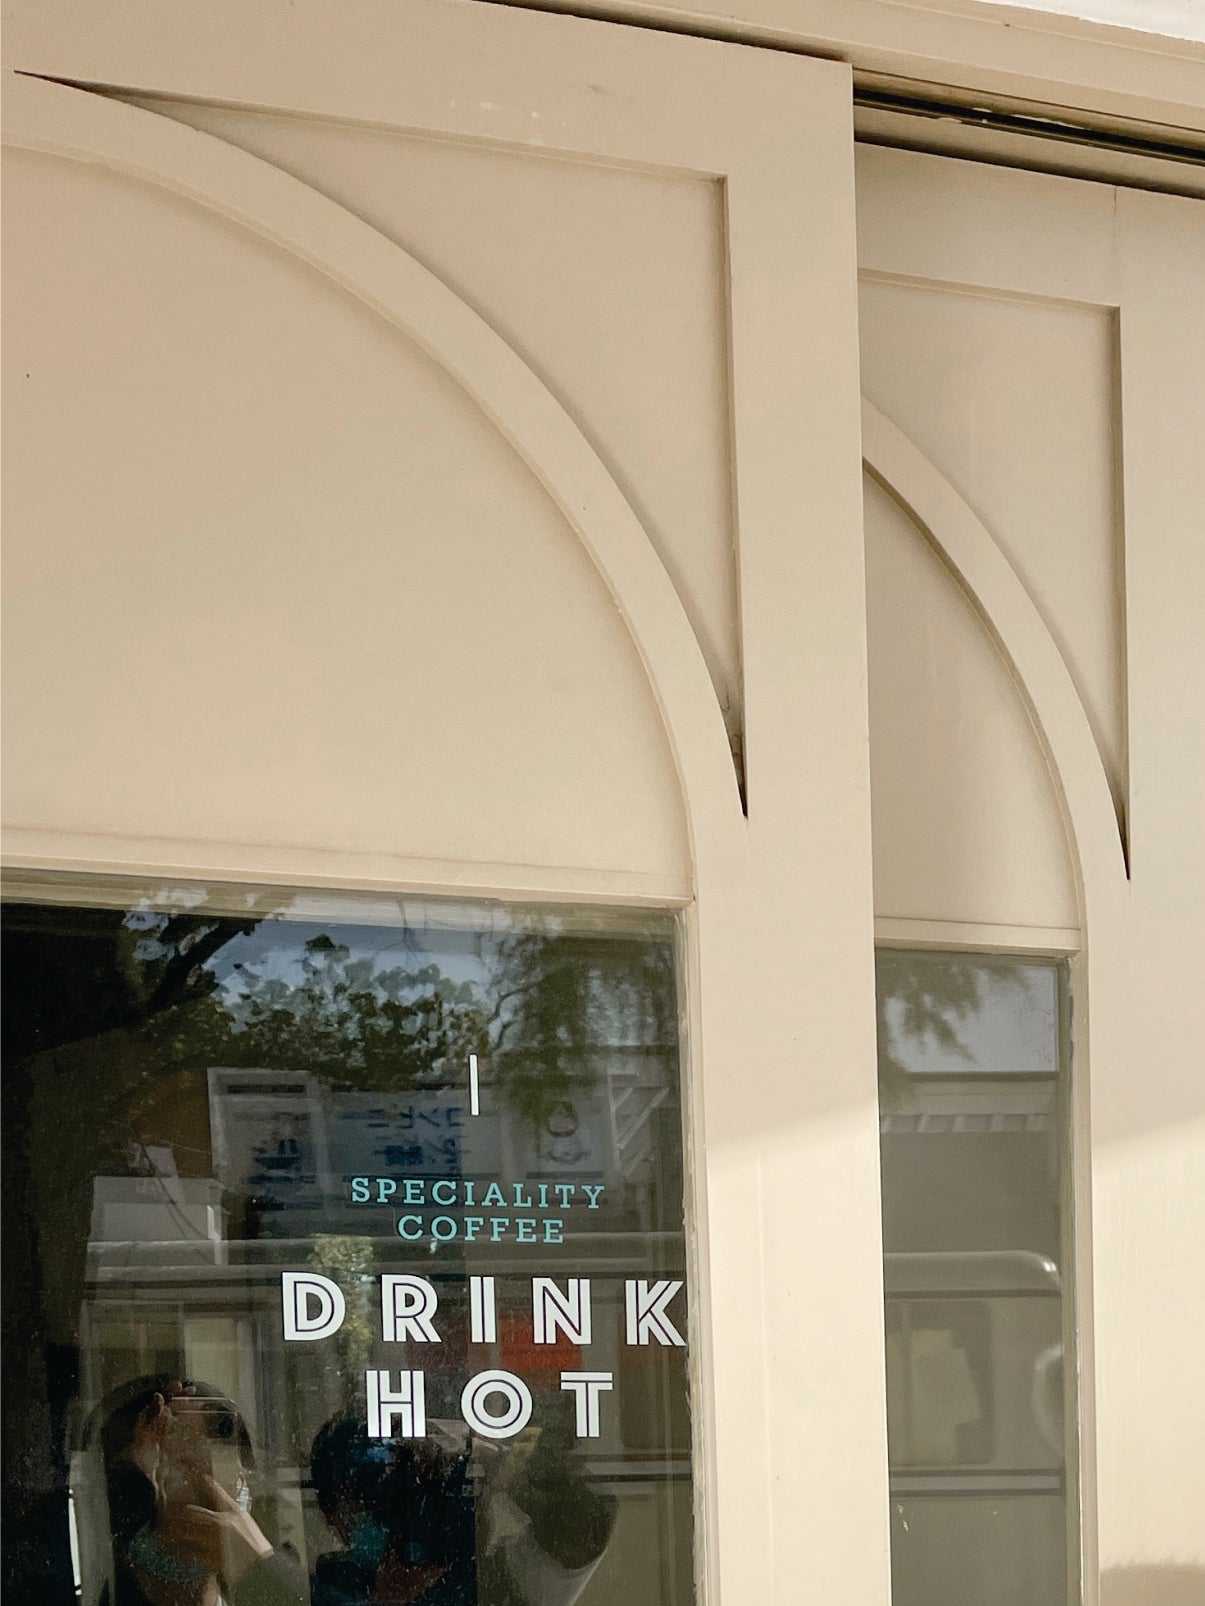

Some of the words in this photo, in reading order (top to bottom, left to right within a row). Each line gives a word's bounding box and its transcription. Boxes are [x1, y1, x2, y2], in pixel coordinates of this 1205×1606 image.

[351, 1177, 605, 1209] SPECIALITY
[397, 1215, 565, 1244] COFFEE
[282, 1272, 687, 1346] DRINK
[366, 1369, 614, 1439] HOT
